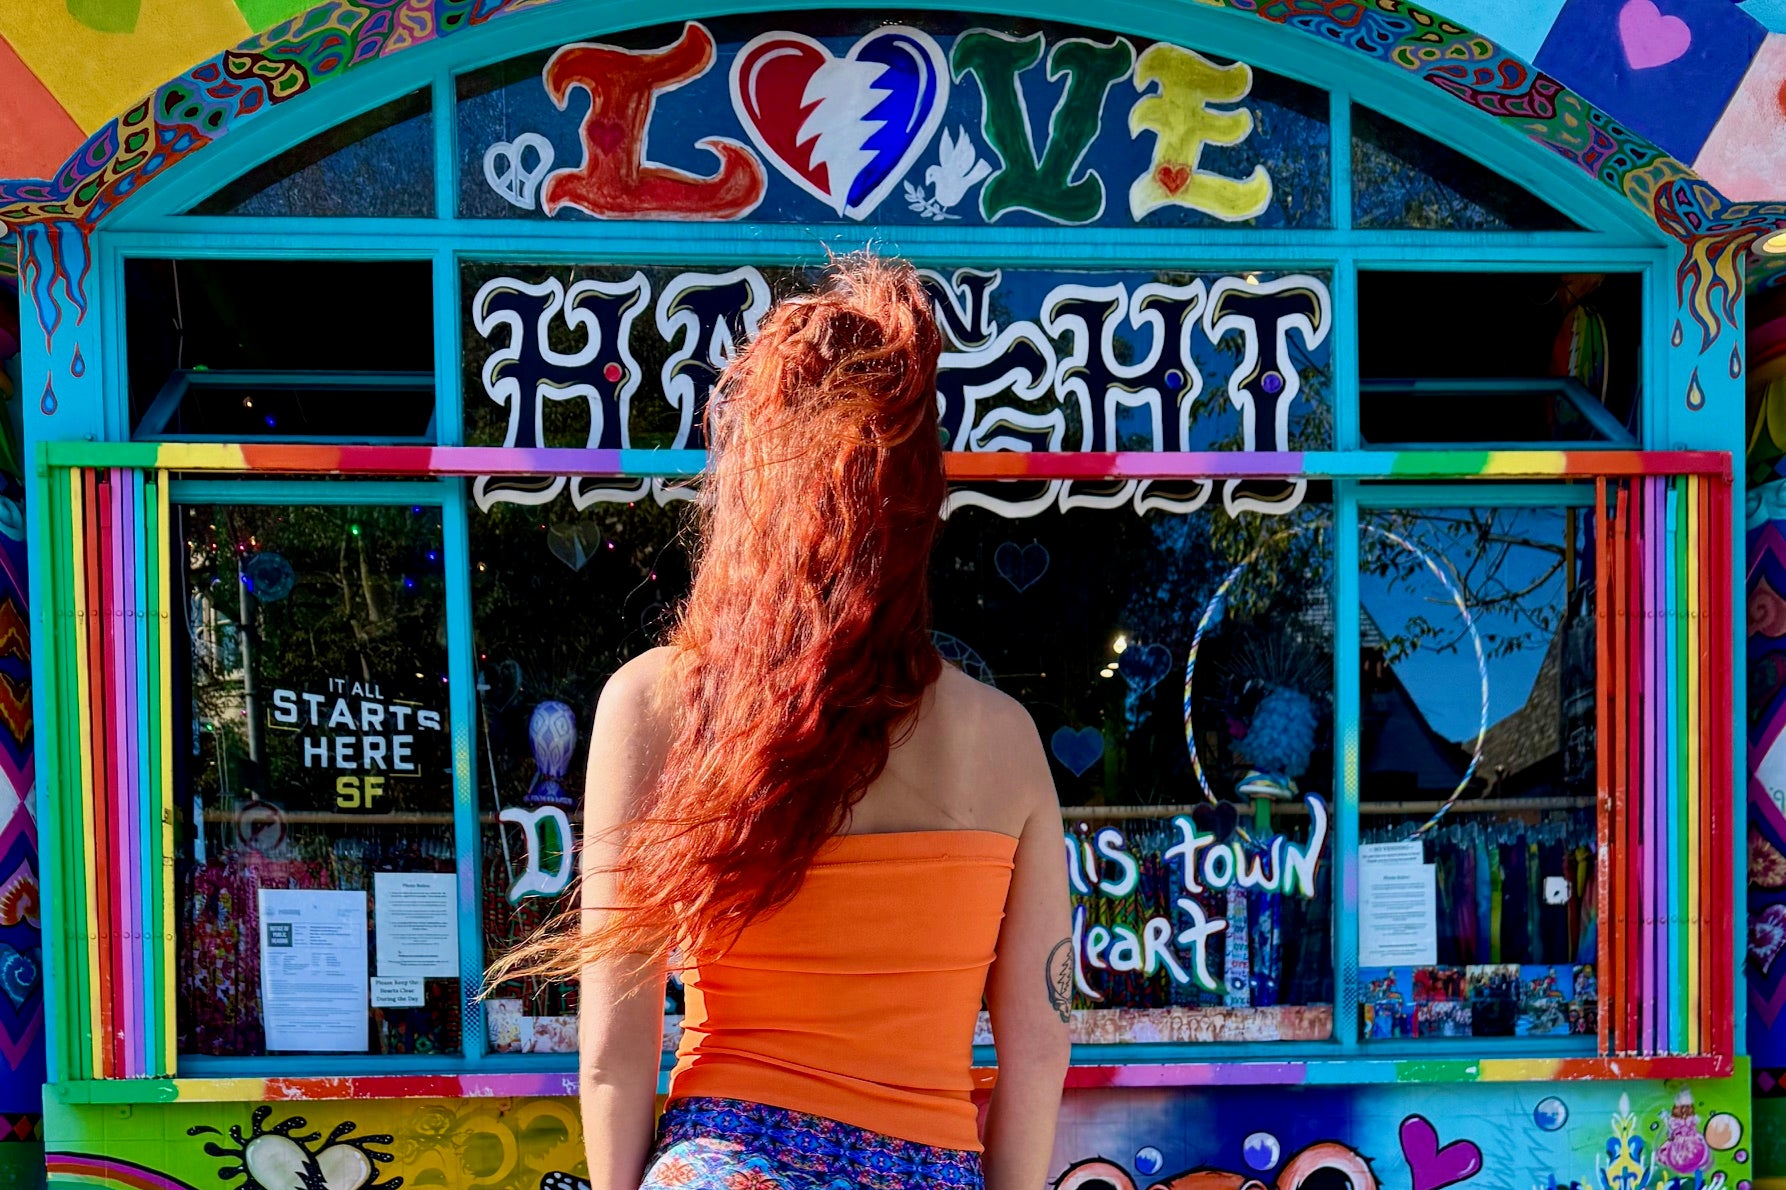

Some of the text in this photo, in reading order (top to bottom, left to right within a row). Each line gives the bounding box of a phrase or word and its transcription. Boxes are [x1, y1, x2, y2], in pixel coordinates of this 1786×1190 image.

[473, 266, 1331, 519] HAGHT
[328, 677, 384, 699] IT ALL
[273, 688, 441, 731] STARTS
[304, 734, 416, 771] HERE
[336, 775, 386, 809] SF
